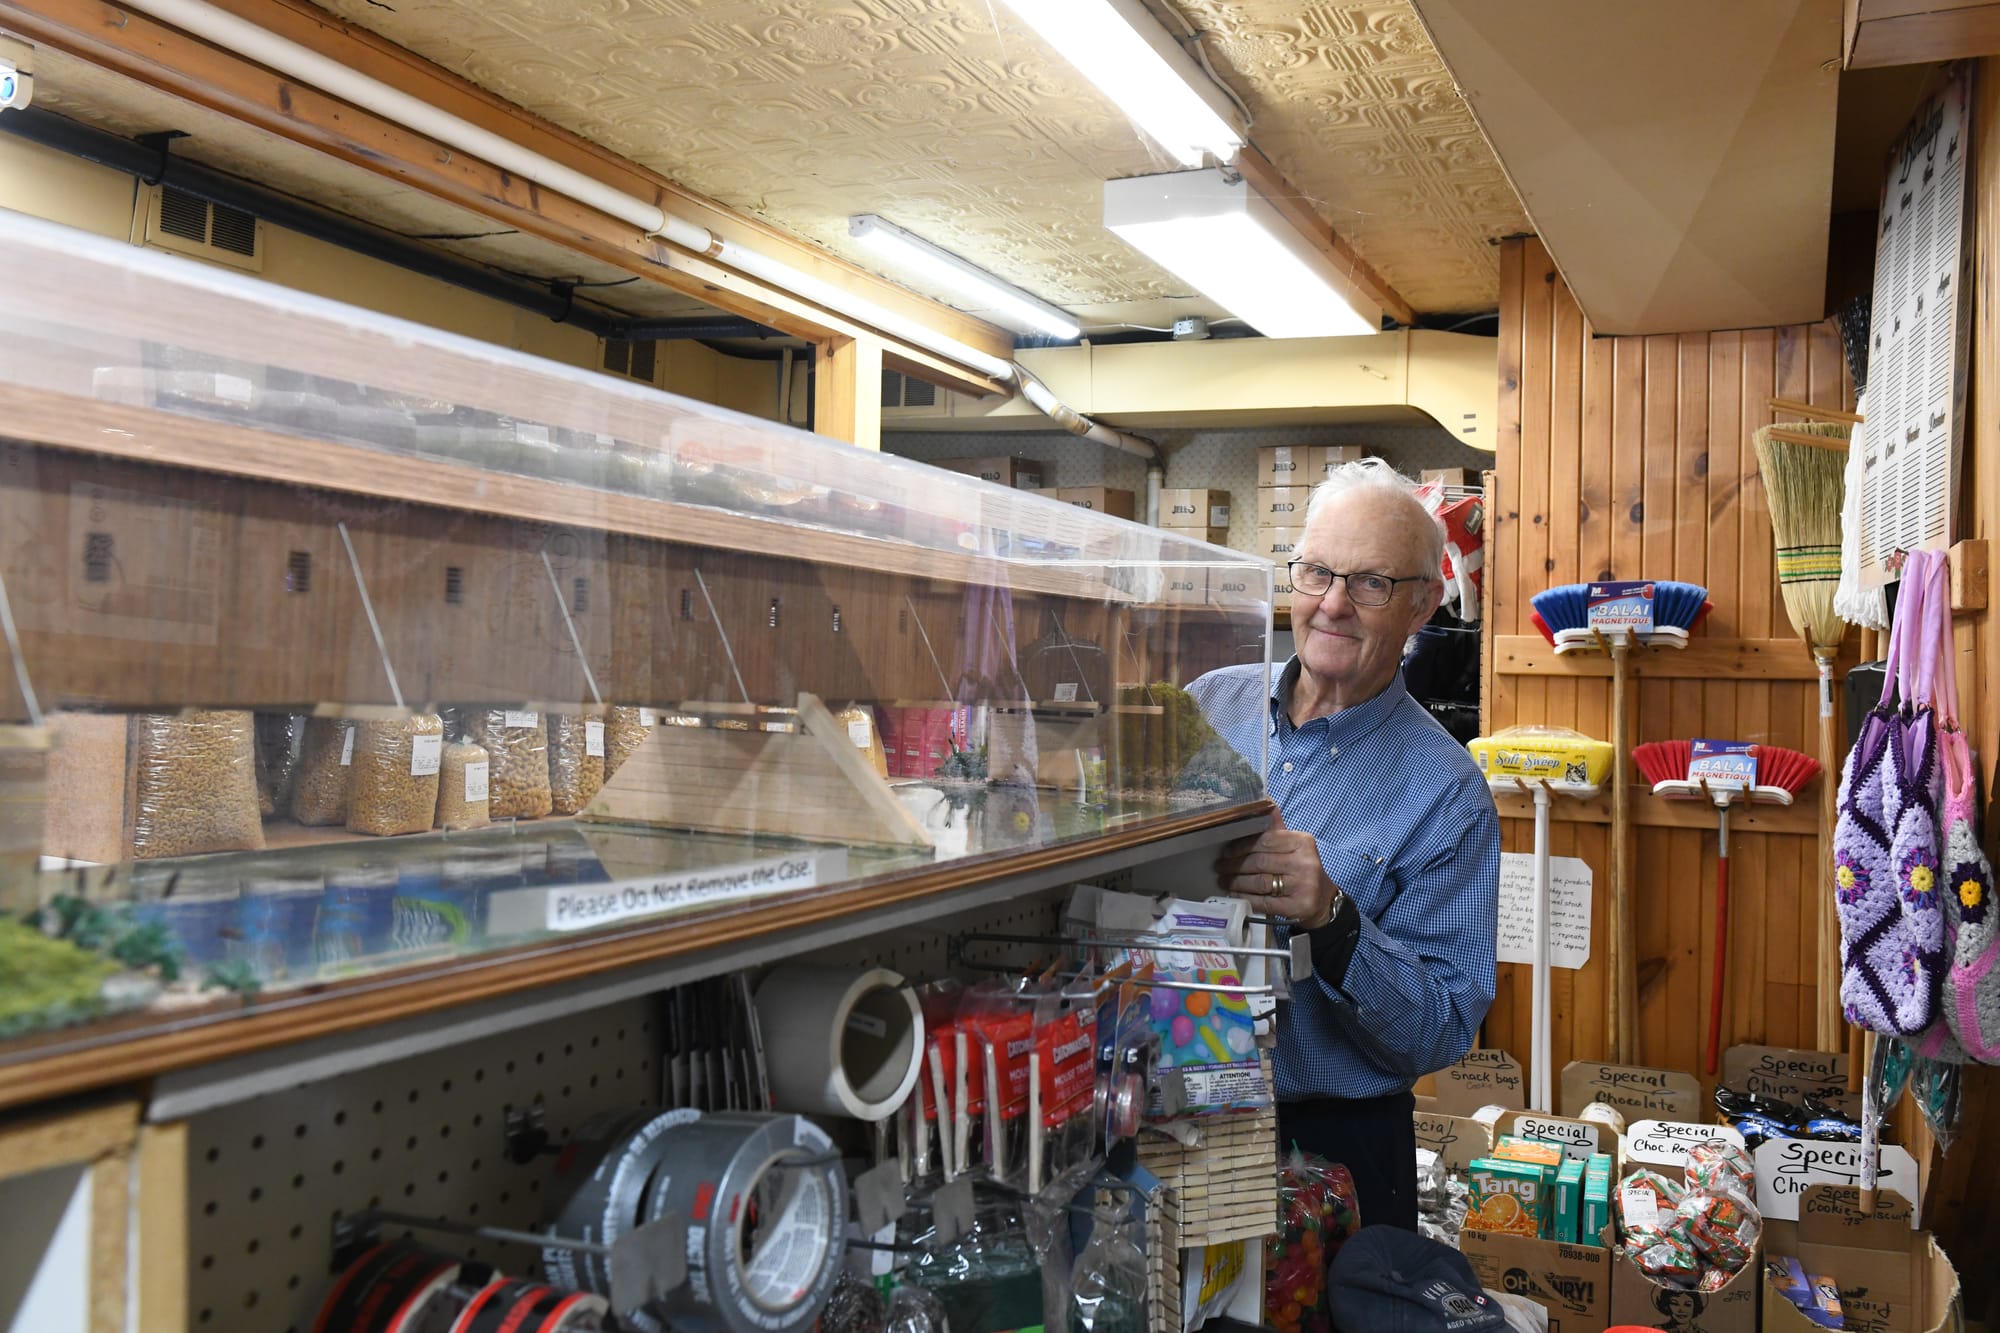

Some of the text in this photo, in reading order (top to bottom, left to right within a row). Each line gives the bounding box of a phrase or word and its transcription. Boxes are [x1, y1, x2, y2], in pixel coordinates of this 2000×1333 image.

[1274, 584, 1293, 593] ELL-O
[1597, 604, 1650, 617] BALAI
[1495, 750, 1560, 769] Soft Sweep
[1699, 760, 1752, 772] BALAI
[556, 892, 618, 922] Please
[622, 887, 648, 910] Do
[650, 881, 682, 903] Not
[686, 874, 749, 898] Remove
[751, 863, 774, 886] the
[1457, 1051, 1507, 1068] pecial
[1760, 1055, 1836, 1076] Special
[1451, 1070, 1520, 1089] Snack bags
[1600, 1067, 1666, 1088] Special
[1746, 1077, 1799, 1100] Chips
[1595, 1090, 1677, 1113] Chocolate
[1413, 1120, 1454, 1137] ecial
[1522, 1120, 1587, 1140] Special
[1653, 1123, 1715, 1138] Special
[1634, 1139, 1669, 1153] Choc.
[1780, 1143, 1882, 1171] Specil
[1472, 1172, 1537, 1202] Tang
[1822, 1186, 1882, 1206] Specl
[1467, 1231, 1487, 1241] 10 kg
[1504, 1274, 1530, 1290] OH
